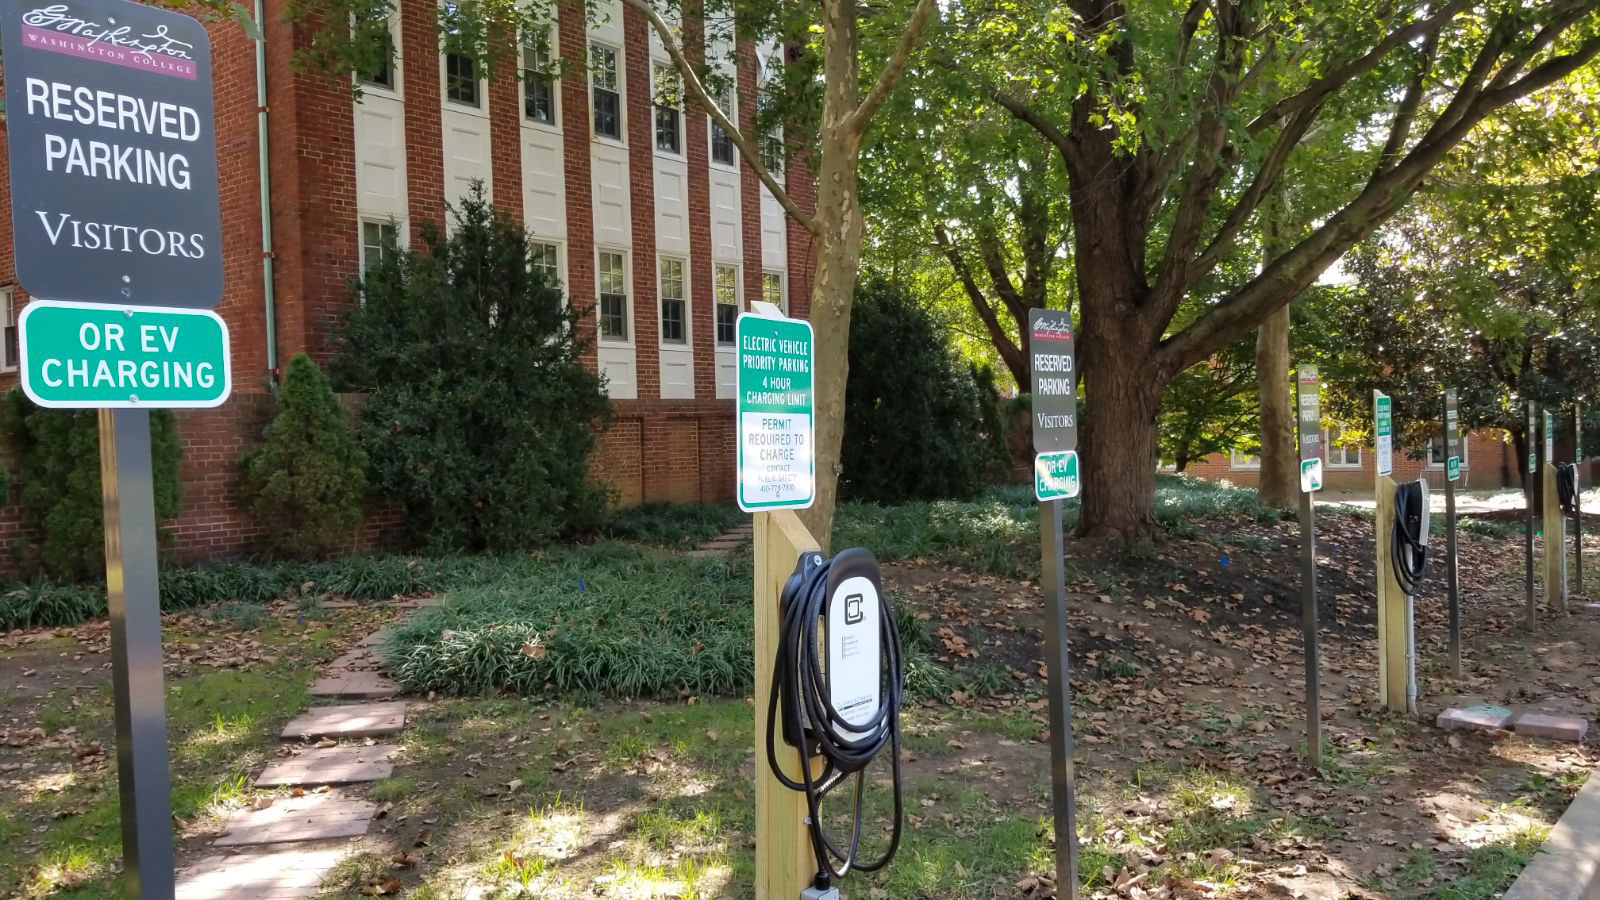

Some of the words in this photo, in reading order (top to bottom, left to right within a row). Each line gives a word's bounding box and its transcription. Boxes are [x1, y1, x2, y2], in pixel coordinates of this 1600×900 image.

[27, 33, 126, 61] WASHINGTON
[132, 55, 193, 75] COLLEGE
[25, 77, 201, 142] RESERVED
[44, 133, 192, 191] PARKING
[35, 210, 206, 259] VISITORS
[79, 322, 125, 352] OR
[140, 324, 180, 353] EV
[743, 335, 777, 353] ELECTRIC
[779, 340, 808, 356] VEHICLE
[743, 354, 776, 371] PRIORITY
[779, 357, 809, 373] PARKING
[1034, 353, 1072, 372] RESERVED
[41, 358, 215, 389] CHARGING
[762, 376, 768, 389] 4
[770, 377, 791, 390] HOUR
[1038, 378, 1070, 396] PARKING
[746, 390, 785, 405] CHARGING
[787, 393, 806, 406] LIMIT
[762, 418, 792, 430] PERMIT
[1037, 412, 1073, 429] VISITORS
[748, 433, 792, 446] REQUIRED
[794, 433, 804, 445] TO
[760, 448, 795, 461] CHARGE
[766, 464, 790, 473] CONTACT
[1046, 460, 1057, 474] OR
[1058, 460, 1068, 473] EV
[1039, 475, 1076, 493] CHARGING
